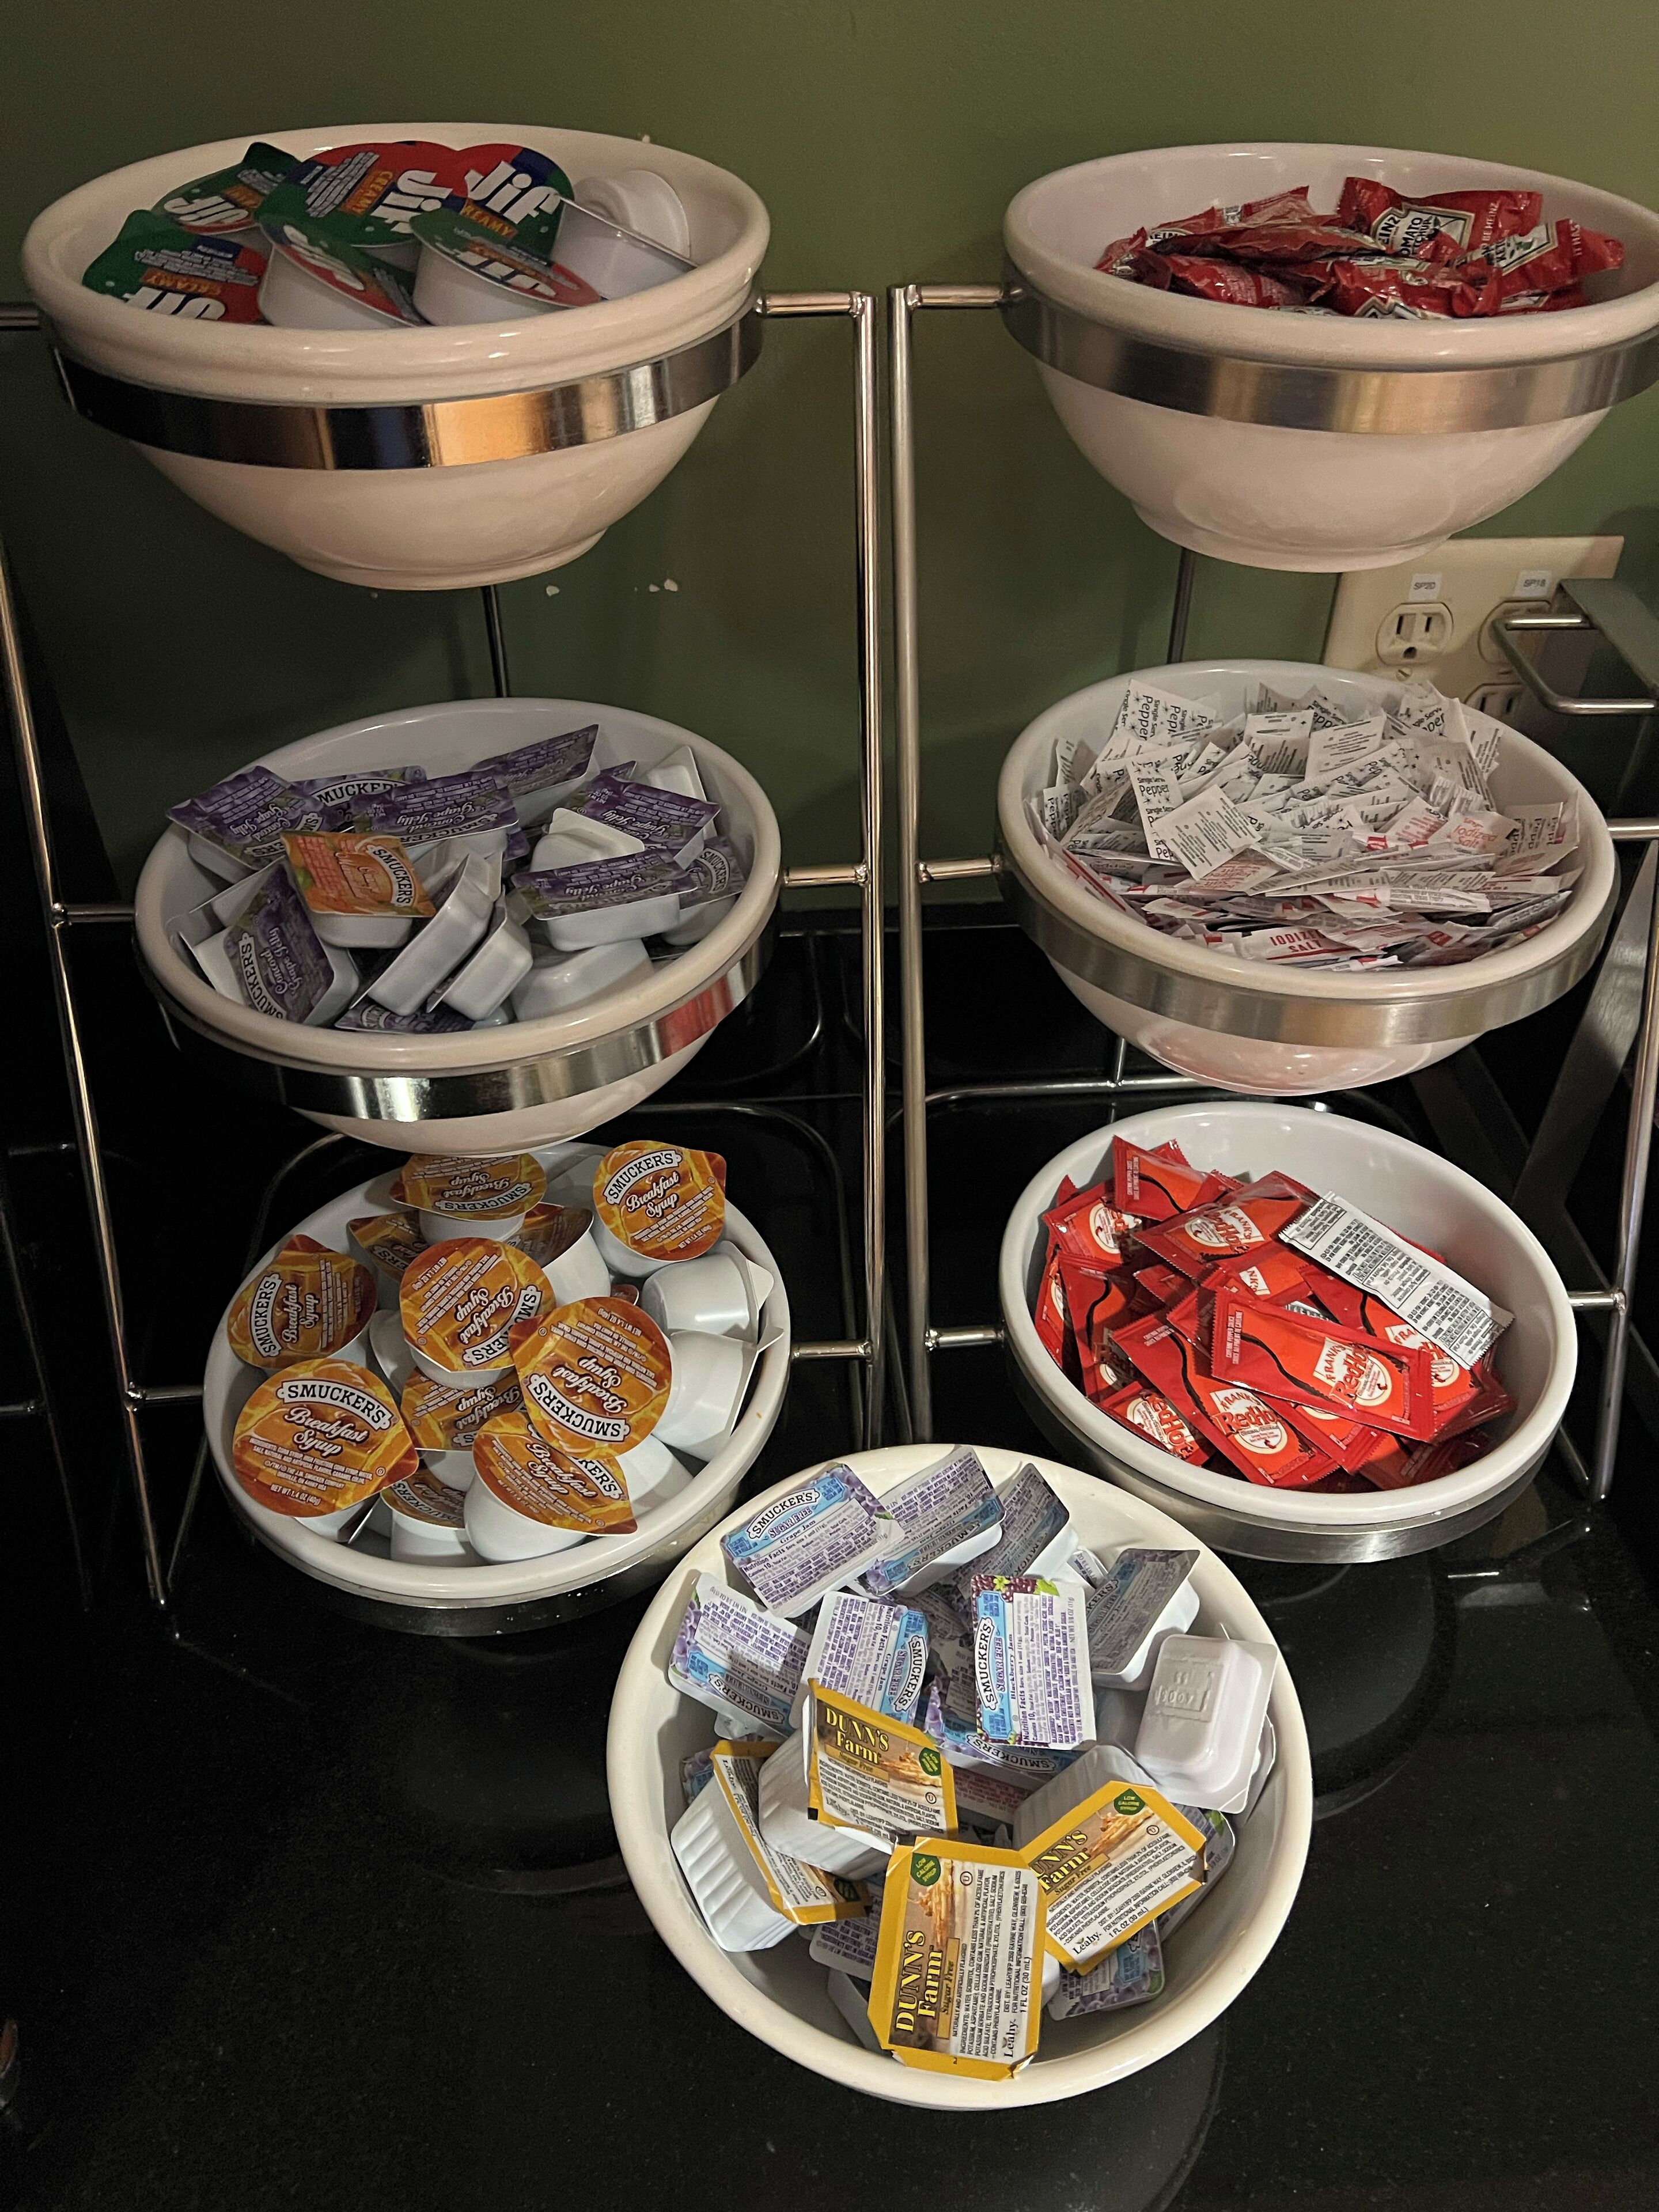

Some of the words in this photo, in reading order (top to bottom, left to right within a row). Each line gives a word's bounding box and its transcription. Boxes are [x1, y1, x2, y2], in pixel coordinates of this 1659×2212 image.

[372, 170, 452, 233] Jif
[464, 161, 560, 224] Jif
[1380, 215, 1400, 246] EINZ
[1400, 217, 1423, 256] OMATO
[1139, 695, 1153, 741] Pepper
[1139, 784, 1169, 797] Pepper
[601, 808, 635, 828] Jelly
[631, 816, 669, 838] Grape
[373, 849, 411, 905] SMUCKER'S
[1287, 940, 1323, 952] SALT
[608, 1153, 673, 1199] SMUCKER'S
[626, 1171, 679, 1212] Breakfast
[646, 1193, 677, 1217] Syrup
[254, 1279, 276, 1354] SMUCKER'S
[282, 1284, 301, 1343] Breakfast
[300, 1294, 319, 1328] Syrup
[456, 1289, 488, 1321] Syrup
[460, 1286, 513, 1344] Breakfast
[578, 1358, 621, 1388] Syrup
[288, 1384, 386, 1424] SMUCKER'S
[458, 1388, 495, 1411] Syrup
[552, 1366, 626, 1414] Breakfast
[284, 1407, 370, 1442] Breakfast
[456, 1391, 518, 1429] Breakfast
[534, 1382, 622, 1437] SMUCKER'S
[293, 1429, 342, 1457] Syrup
[527, 1442, 597, 1498] Breakfast
[529, 1461, 569, 1494] Syrup
[270, 1483, 282, 1492] NET
[299, 1492, 308, 1501] OZ
[752, 1492, 813, 1534] SMUCKER'S
[768, 1514, 793, 1537] SUGAR
[790, 1508, 812, 1526] FREE
[779, 1528, 801, 1544] Grape
[801, 1519, 816, 1531] Jam
[743, 1555, 768, 1573] Nutrition
[768, 1546, 785, 1560] Facts
[763, 1560, 774, 1570] 10,
[873, 1622, 882, 1632] 10,
[876, 1605, 884, 1622] Calories
[881, 1607, 894, 1633] Nutrition
[878, 1634, 887, 1651] Facts
[993, 1638, 1003, 1660] FREE
[895, 1650, 907, 1672] SUGAR
[899, 1641, 921, 1706] SMUCKER'S
[978, 1623, 997, 1703] SMUCKER'S
[1007, 1654, 1017, 1699] Blackberry
[770, 1680, 787, 1692] Facts
[877, 1676, 885, 1691] Jam
[889, 1672, 901, 1695] FREE
[994, 1662, 1005, 1692] SUGAR
[715, 1679, 779, 1719] SMUCKER'S
[825, 1707, 889, 1752] DUNN'S
[1021, 1710, 1029, 1740] Nutrition
[836, 1730, 880, 1765] Farm
[974, 1740, 1050, 1768] SMUCKER'S
[915, 1857, 927, 1869] LOW
[1039, 1848, 1090, 1891] Farm
[1054, 1878, 1076, 1896] Sugar
[1077, 1865, 1091, 1878] Free
[1112, 1926, 1122, 1935] FL
[1119, 1920, 1130, 1930] OZ
[1128, 1914, 1139, 1924] (30
[1135, 1906, 1149, 1918] mL)
[946, 1960, 955, 1976] Free
[1022, 1956, 1032, 1971] mL)
[1022, 1972, 1031, 1983] (30
[895, 1930, 925, 2032] DUNN'S
[918, 1950, 942, 2017] Farm
[941, 1979, 952, 2014] Sugar
[1012, 1968, 1021, 2001] NUTRITIONAL
[1021, 1985, 1028, 1995] OZ
[1020, 1997, 1027, 2006] FL
[959, 2012, 969, 2053] INGREDIENTS:
[975, 2028, 983, 2055] POTASSIUM
